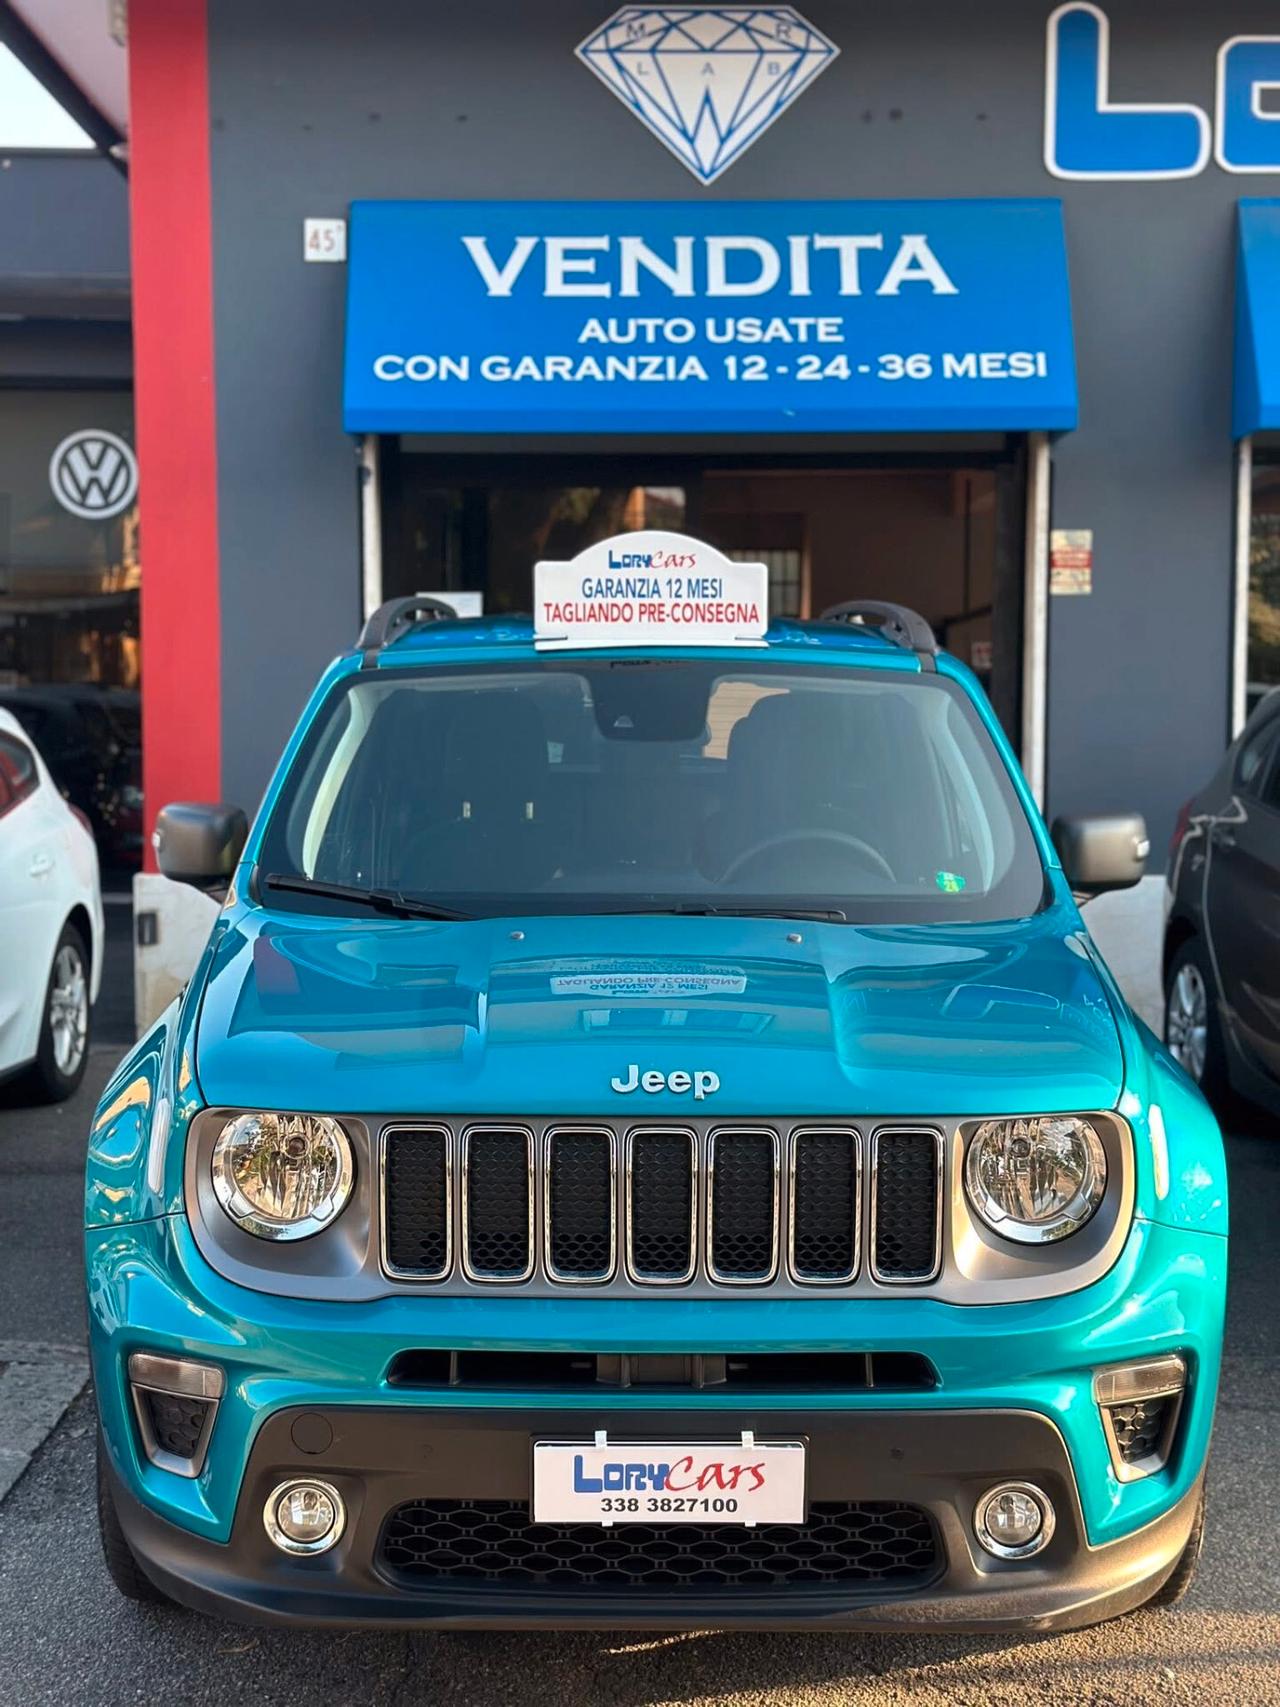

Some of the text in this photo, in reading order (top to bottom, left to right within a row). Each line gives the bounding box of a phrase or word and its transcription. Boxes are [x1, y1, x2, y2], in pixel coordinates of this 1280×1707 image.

[462, 234, 958, 298] VENDITA
[578, 317, 844, 344] AUTO USATE
[373, 355, 469, 381] CON
[480, 355, 708, 382] GARANZIA
[724, 355, 768, 381] 12
[796, 354, 851, 380] 24
[878, 353, 932, 380] 36
[942, 351, 1047, 379] MESI
[581, 578, 723, 599] GARANZIA 12 MESI
[544, 602, 760, 623] TAGLIANDO PRE-CONSEGNA
[611, 1064, 720, 1099] Jeep
[601, 1498, 738, 1512] 338 3827100
